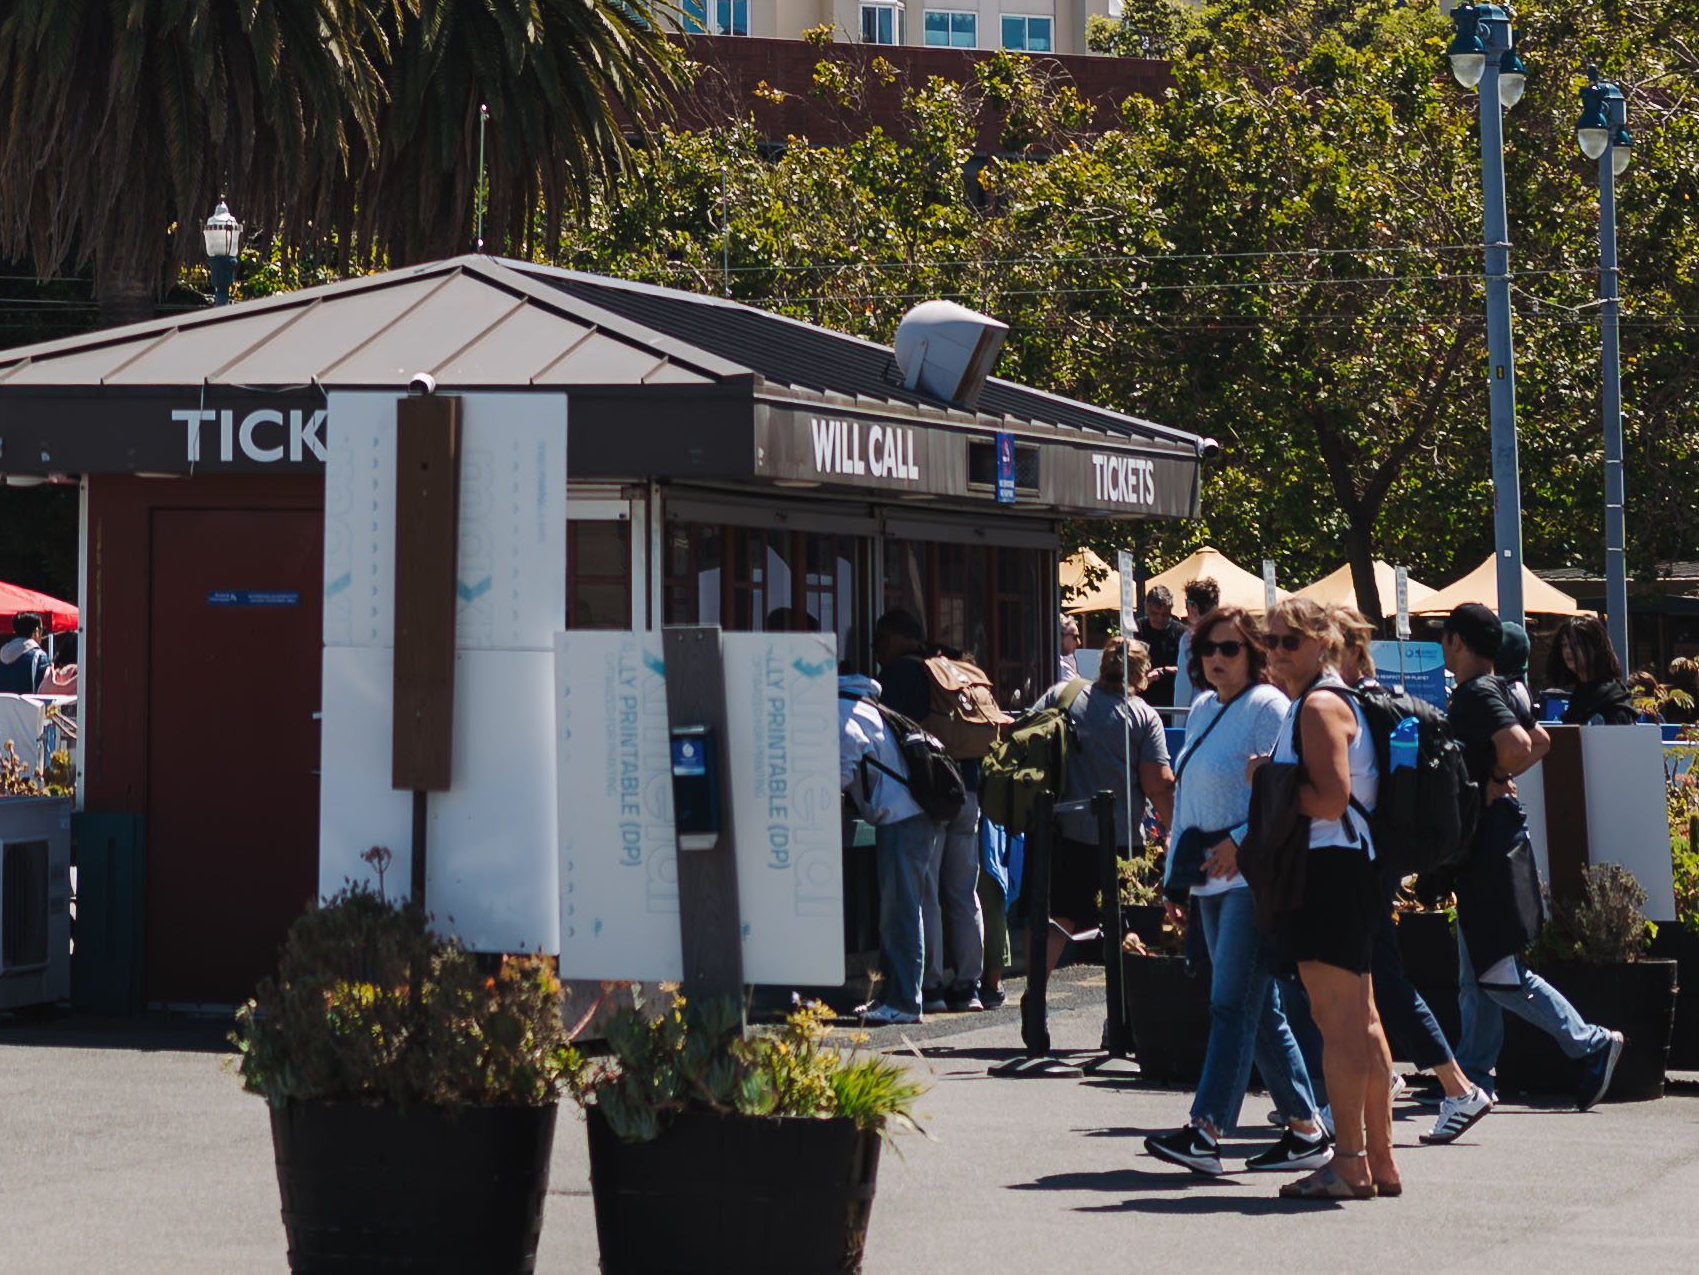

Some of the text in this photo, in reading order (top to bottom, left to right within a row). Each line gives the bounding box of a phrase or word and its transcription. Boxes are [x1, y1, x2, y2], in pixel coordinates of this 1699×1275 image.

[172, 409, 327, 462] TICK
[811, 418, 919, 480] WILL CALL
[1092, 453, 1155, 505] TICKETS
[619, 696, 641, 816] PRINTABLE
[767, 697, 789, 820] PRINTABLE
[619, 821, 642, 867] (DP)
[767, 825, 790, 870] (DP)
